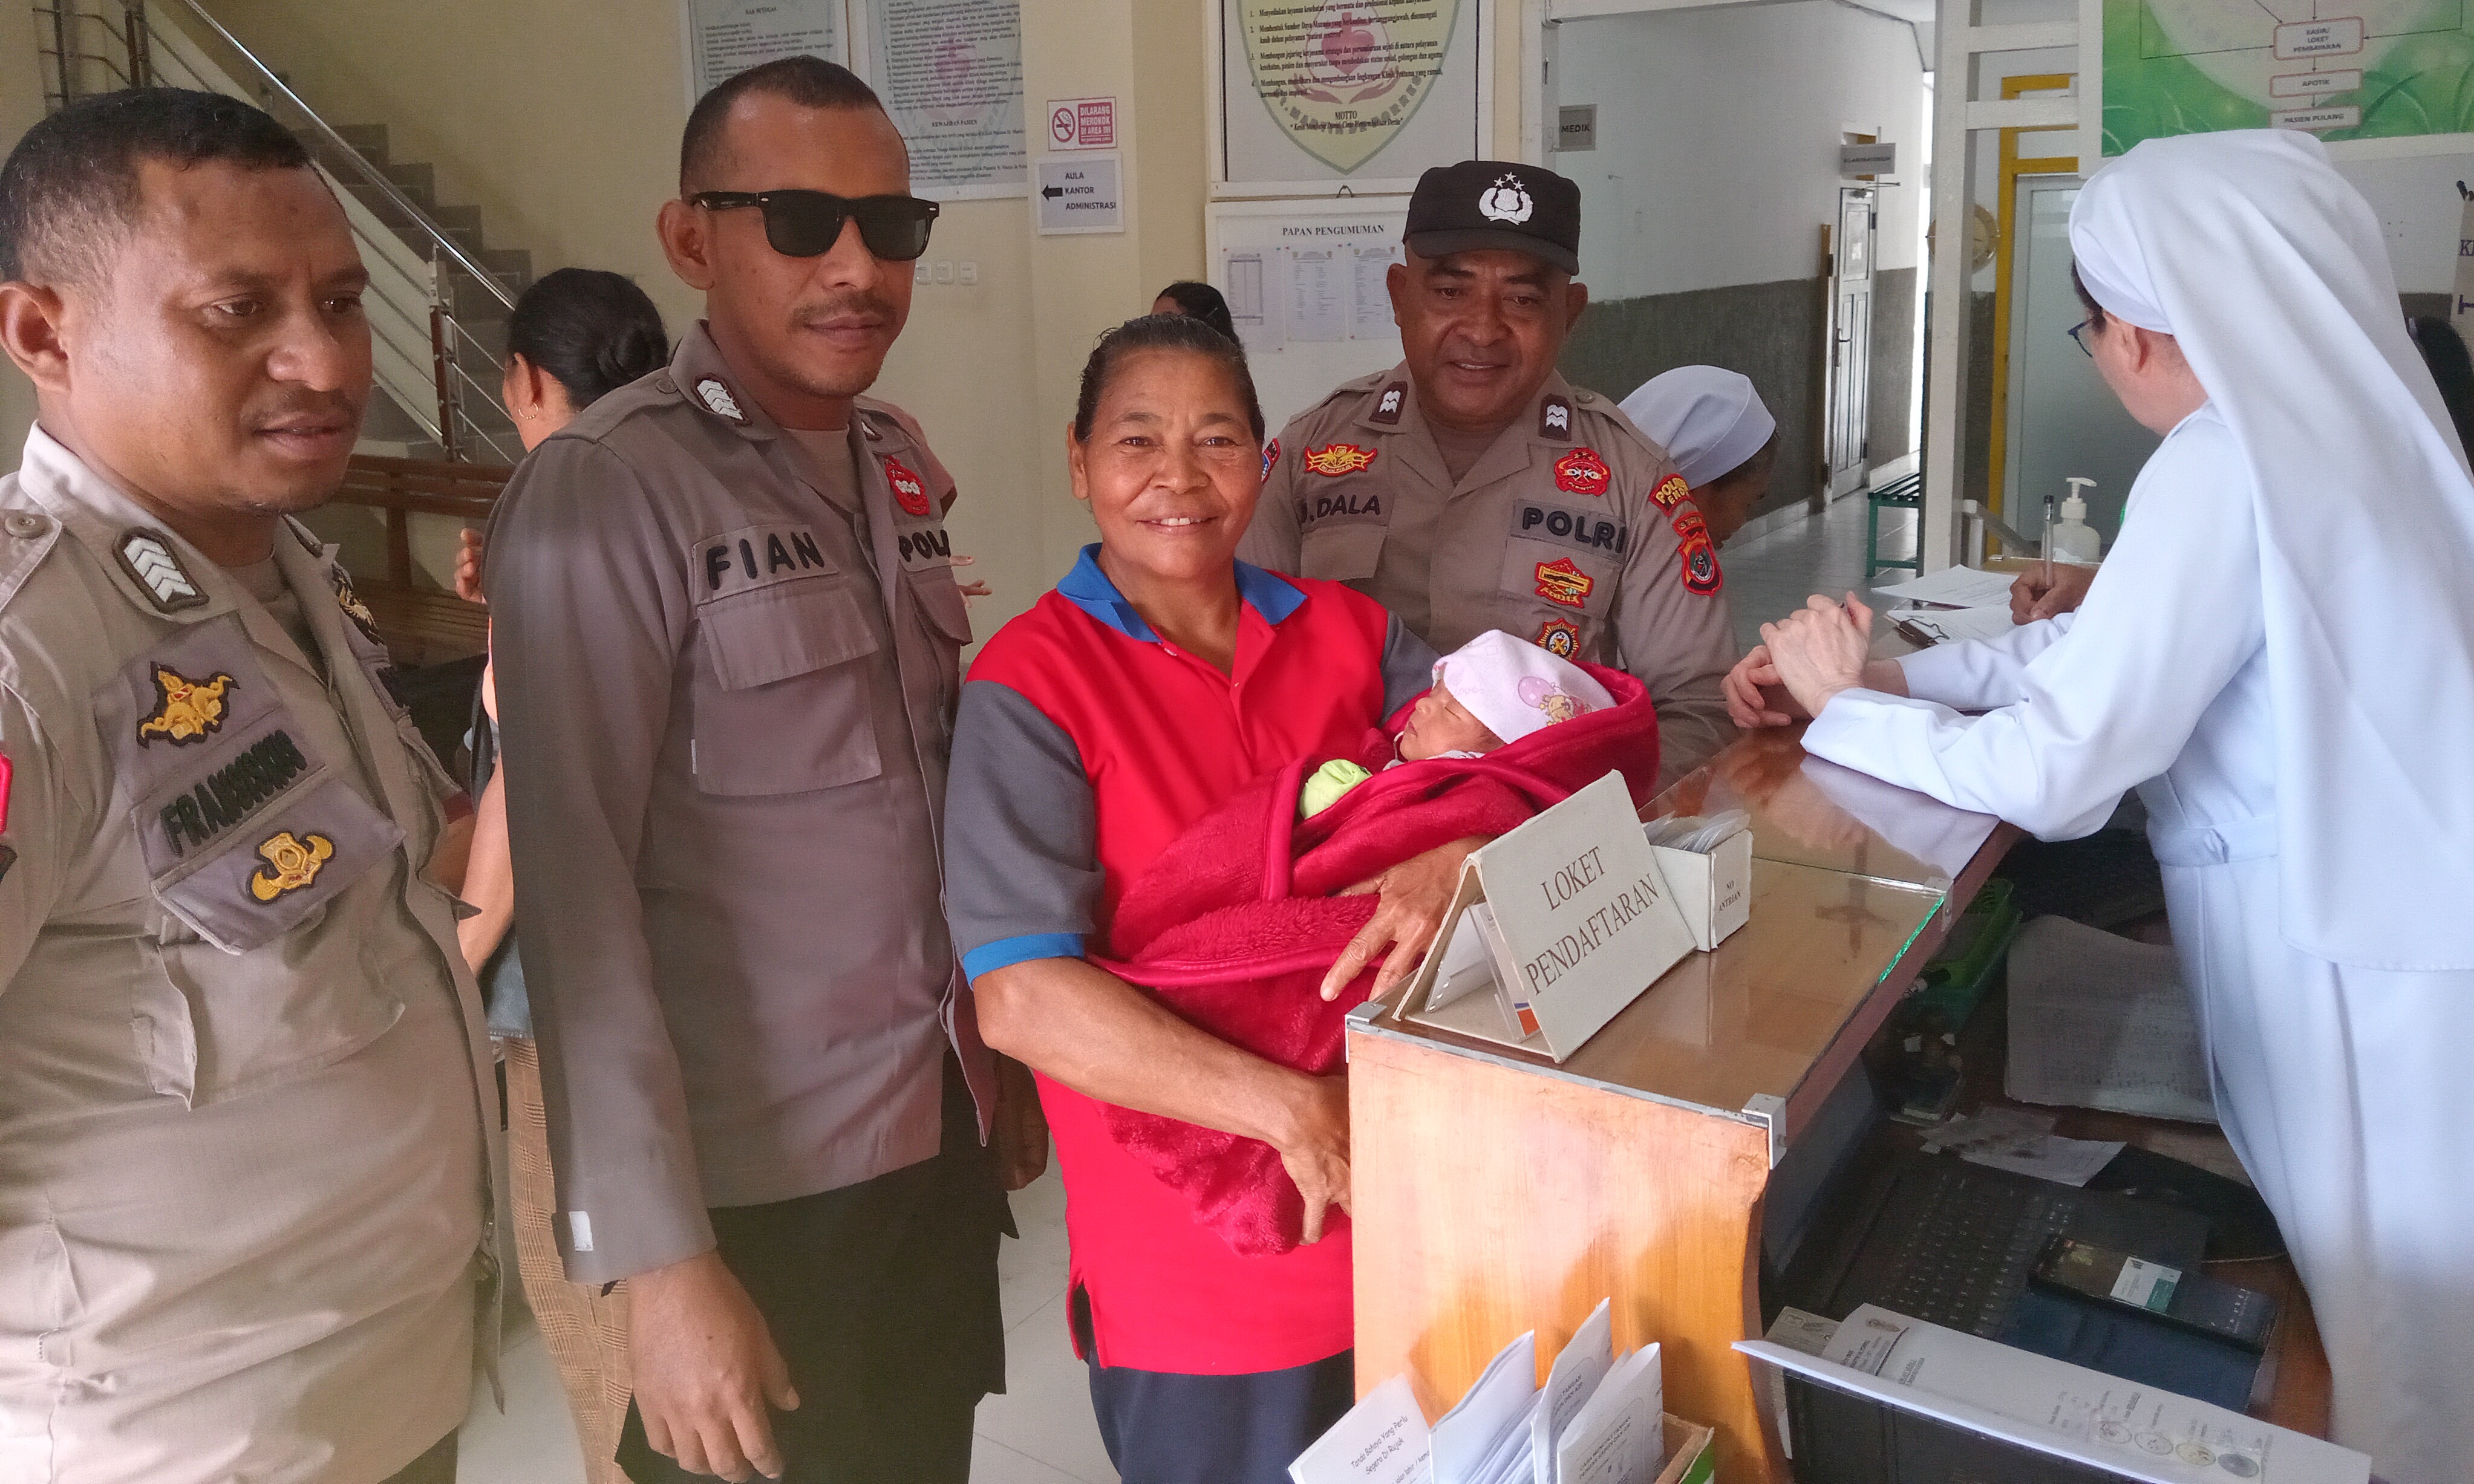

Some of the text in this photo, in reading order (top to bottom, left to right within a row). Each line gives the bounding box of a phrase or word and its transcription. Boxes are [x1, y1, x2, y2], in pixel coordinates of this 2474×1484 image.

[1080, 105, 1111, 116] DILARANG
[1334, 111, 1358, 120] MOTTO
[1080, 116, 1111, 126] MEROKOK
[1561, 124, 1590, 133] MEDIK
[1065, 186, 1094, 195] KANTOR
[1065, 201, 1116, 210] ADMINISTRASI
[1282, 224, 1385, 236] PAPAN PENGUMUMAN
[1522, 507, 1628, 554] POLRI
[706, 532, 824, 590] FIAN
[1541, 846, 1606, 911] LOKET
[1726, 880, 1734, 890] NO
[1718, 890, 1741, 912] ANTRIAN
[1524, 873, 1660, 995] PENDAFTARAN
[1351, 1415, 1408, 1469] Tanda Bahaya Yang Perlu
[1366, 1436, 1405, 1475] Segera Di Rujuk
